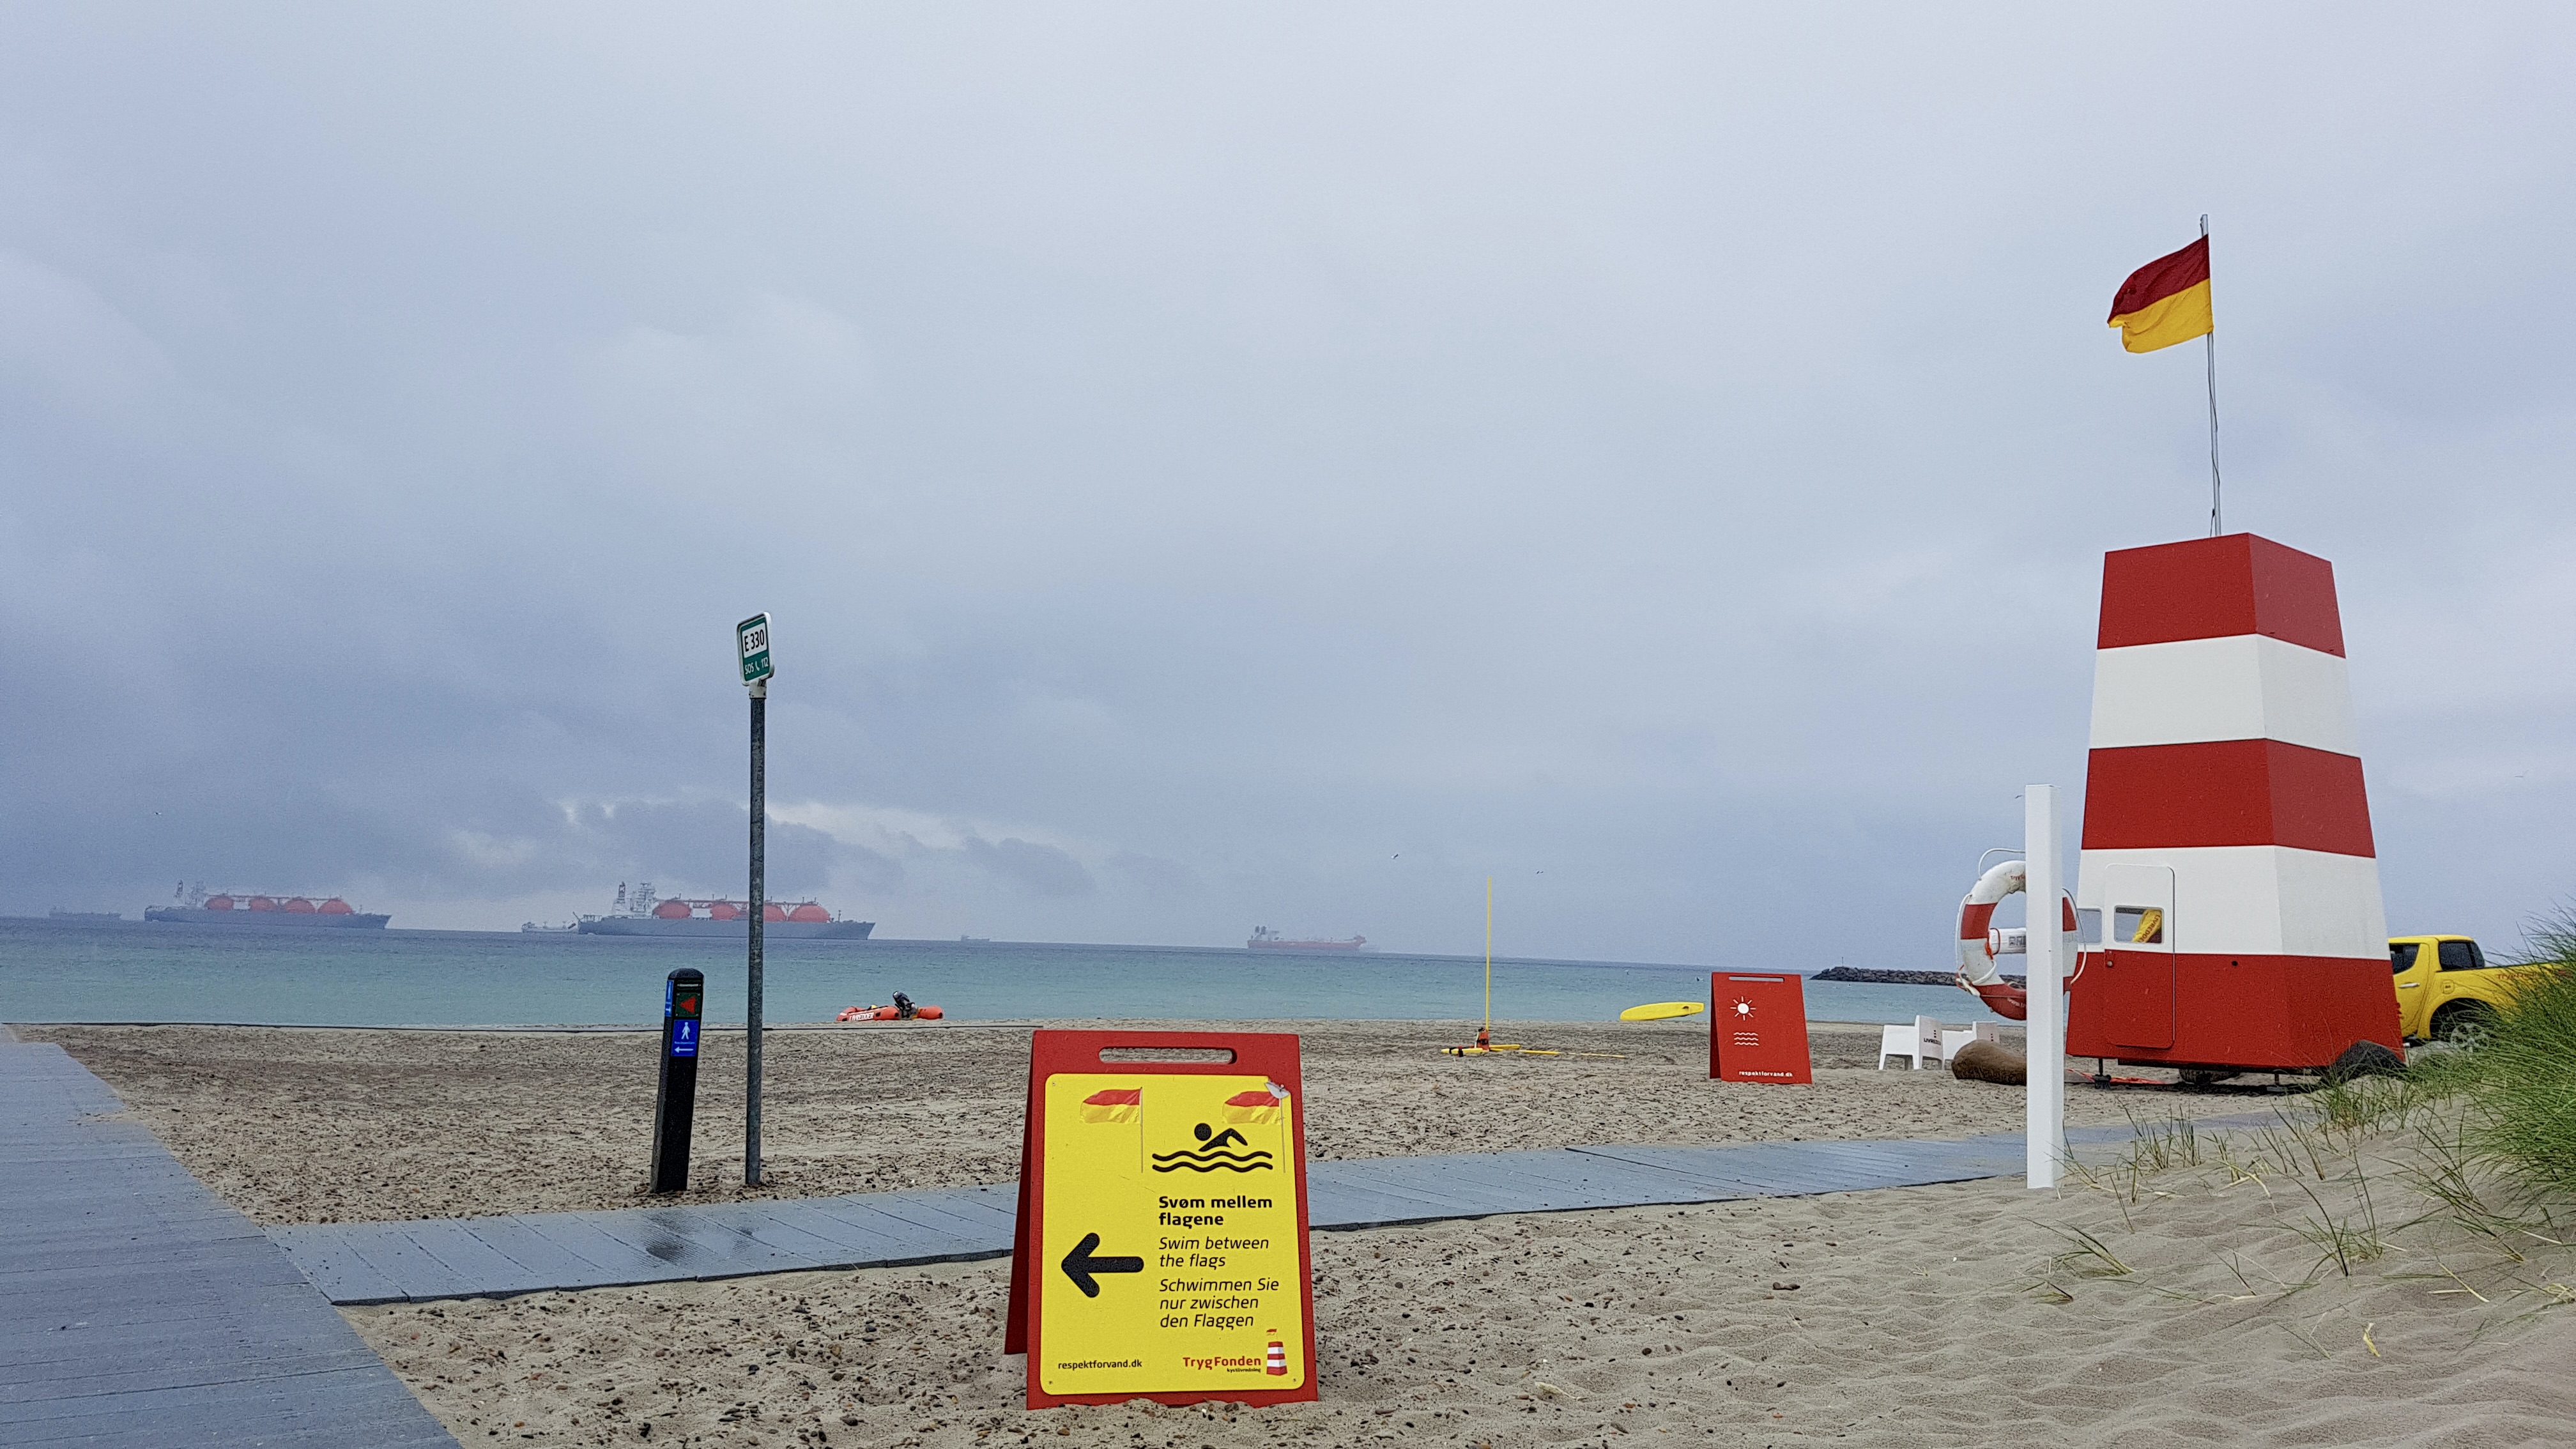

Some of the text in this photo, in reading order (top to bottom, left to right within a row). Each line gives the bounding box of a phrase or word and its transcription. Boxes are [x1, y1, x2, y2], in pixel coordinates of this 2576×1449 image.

[744, 629, 764, 652] E 330
[745, 663, 754, 675] SOS
[1159, 1195, 1272, 1208] Svøm mellem
[1158, 1212, 1224, 1229] flagene
[1159, 1236, 1269, 1250] Swim between
[1160, 1254, 1226, 1270] the flags
[1159, 1277, 1279, 1291] Schwimmen Sie
[1160, 1295, 1259, 1310] nur zwischen
[1160, 1313, 1254, 1330] den Flaggen
[1058, 1359, 1142, 1370] respektforvand.dk
[1183, 1355, 1261, 1370] TrygFonden
